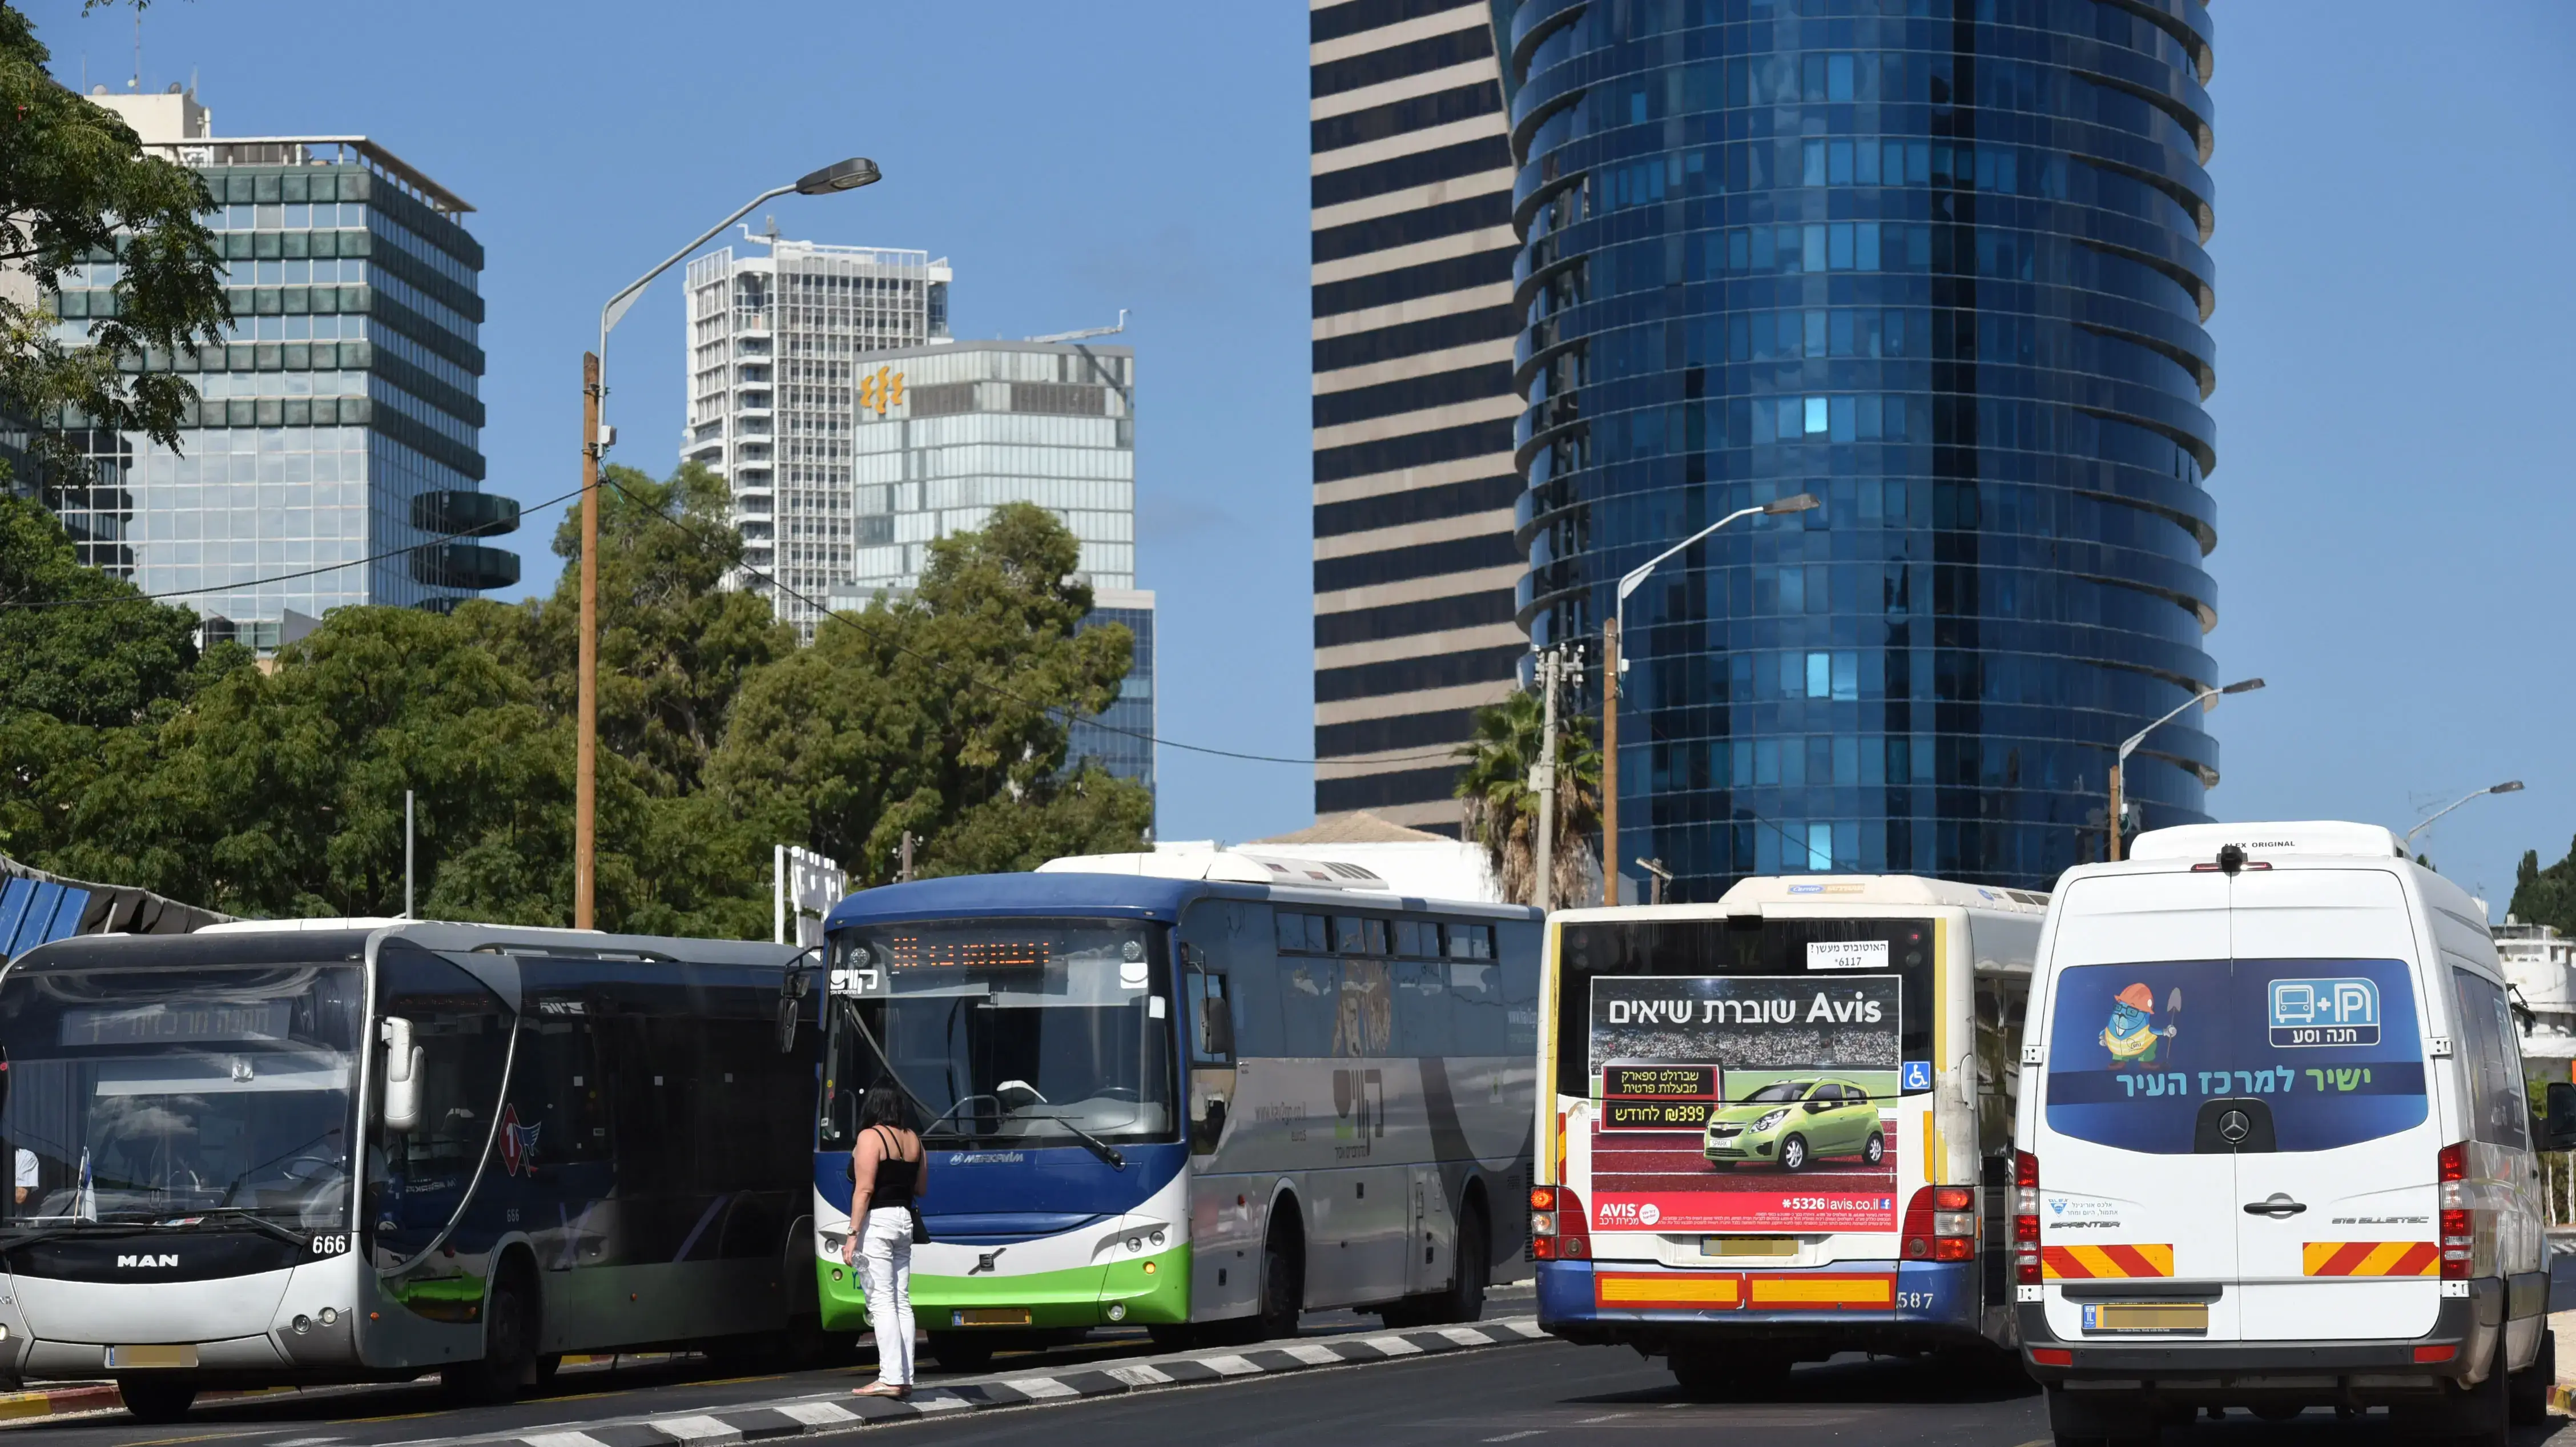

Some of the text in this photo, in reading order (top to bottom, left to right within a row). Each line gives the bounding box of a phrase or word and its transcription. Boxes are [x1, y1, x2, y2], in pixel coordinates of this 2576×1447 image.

[1843, 943, 1886, 952] האוטובוס
[1609, 991, 1882, 1024] Avis שוברת שיאים
[2293, 1028, 2357, 1043] חנה וסע
[1621, 1070, 1699, 1083] שברולט ספארק
[2116, 1064, 2371, 1097] ישיר למרכז העיר
[1623, 1082, 1697, 1093] מבעלות פרטית
[1615, 1104, 1660, 1121] לחודש
[1599, 1203, 1636, 1217] AVIS
[1830, 1198, 1878, 1211] avis.co.il
[1599, 1217, 1639, 1225] מכירת רכב
[2358, 1216, 2429, 1224] BLUETEC
[312, 1235, 346, 1254] 666
[117, 1254, 179, 1267] MAN
[1897, 1292, 1934, 1309] 587
[2086, 1312, 2094, 1322] IL
